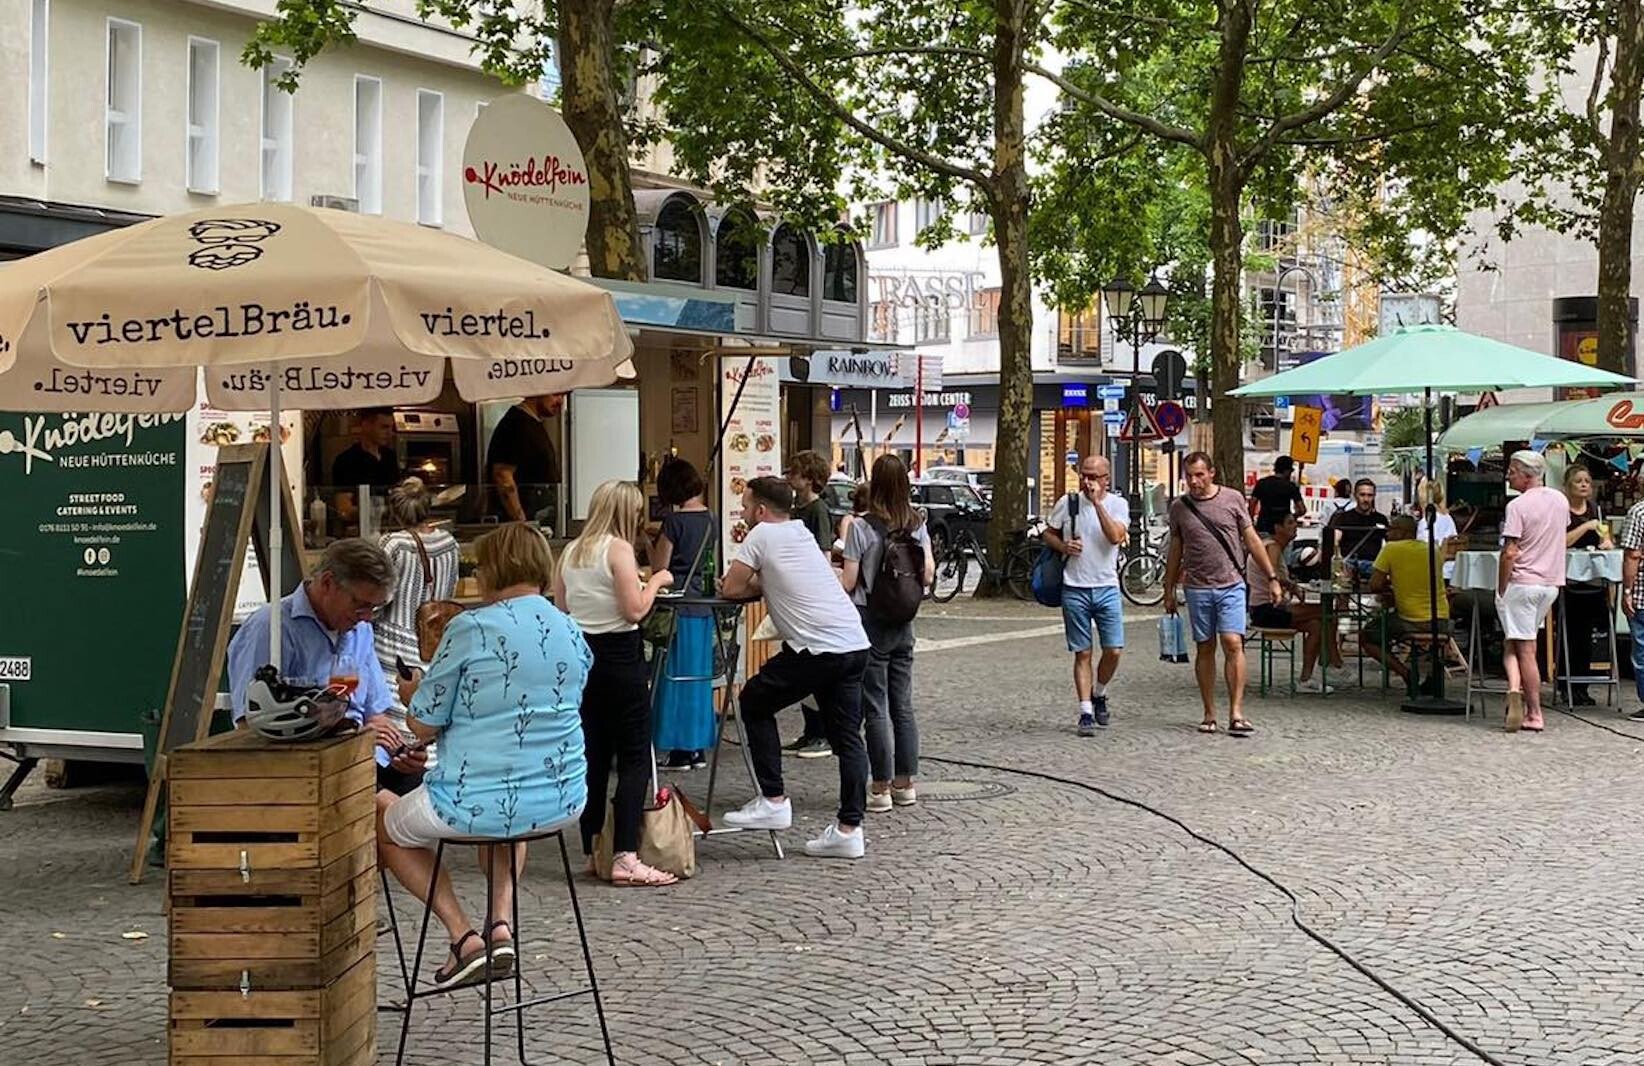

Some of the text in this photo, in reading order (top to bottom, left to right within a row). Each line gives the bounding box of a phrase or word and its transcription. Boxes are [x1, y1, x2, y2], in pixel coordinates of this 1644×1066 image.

[477, 155, 586, 200] Knödelfein
[67, 301, 352, 344] viertelBräu.
[420, 307, 551, 339] viertel.
[889, 393, 911, 407] ZEISS
[940, 391, 972, 407] CENTER
[60, 452, 177, 468] NEUE HÜTTENKÜCHE
[69, 493, 125, 504] STREET FOOD
[56, 506, 97, 516] CATERING
[105, 505, 138, 515] EVENTS
[0, 661, 29, 677] 2488
